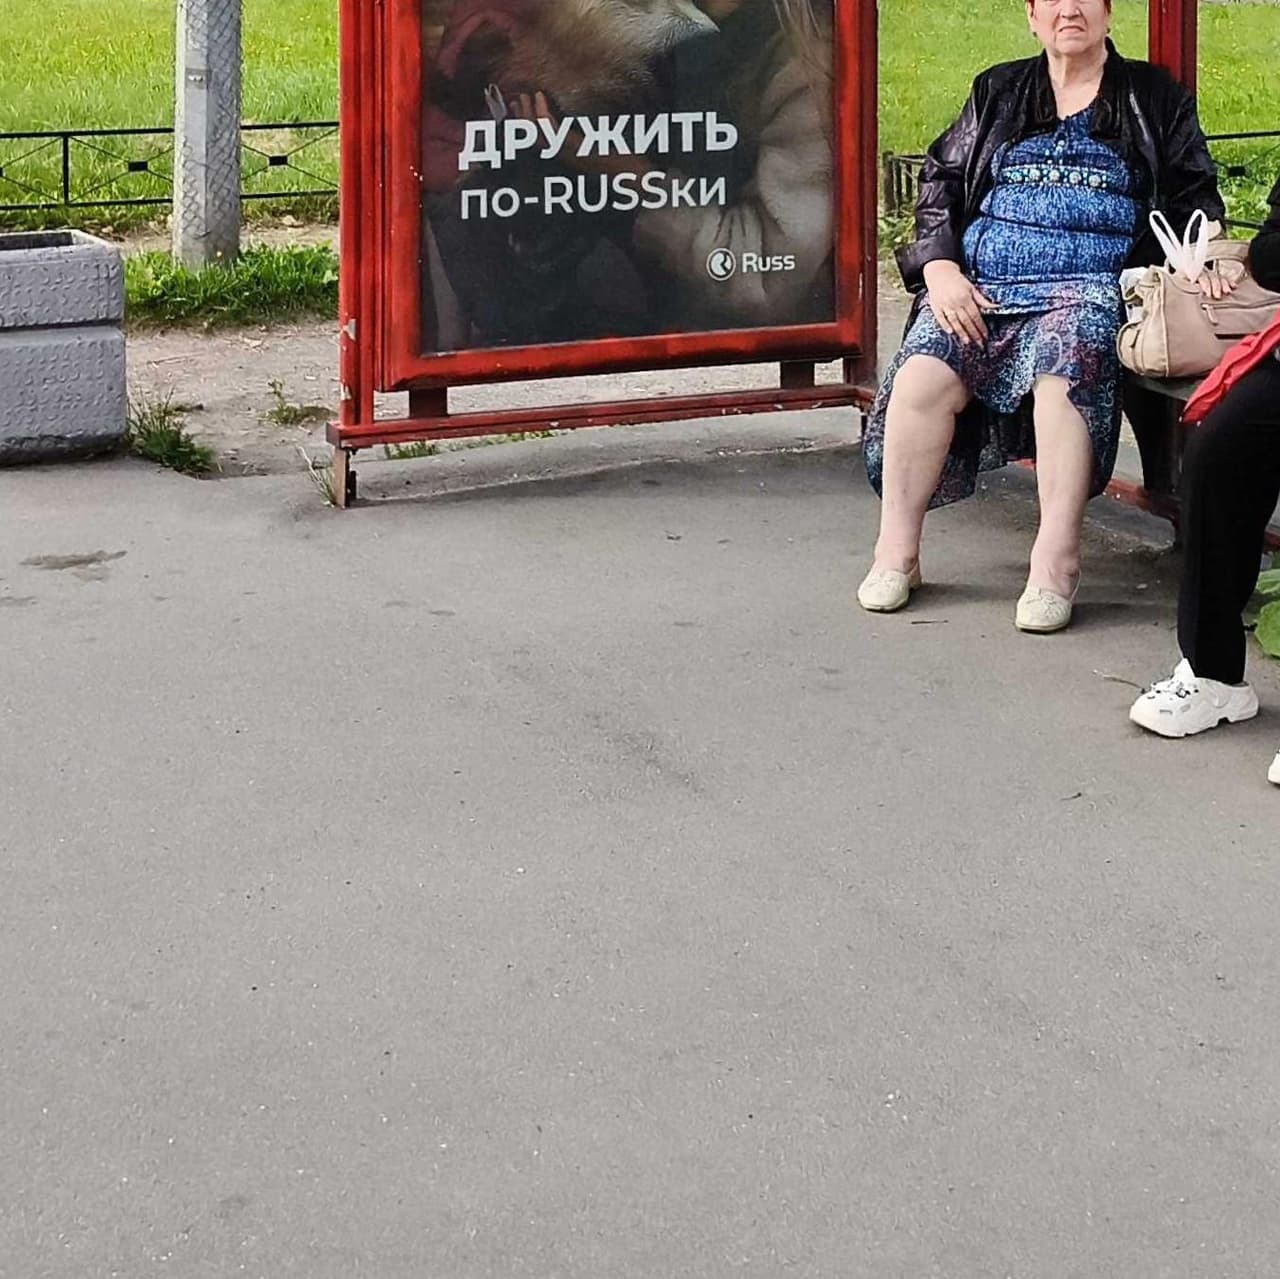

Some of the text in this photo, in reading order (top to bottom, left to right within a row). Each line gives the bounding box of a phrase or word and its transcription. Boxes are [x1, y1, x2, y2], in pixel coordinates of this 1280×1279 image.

[458, 111, 738, 171] ДРУЖИТЬ
[461, 172, 726, 220] по-RUSSки
[742, 252, 795, 273] Russ
